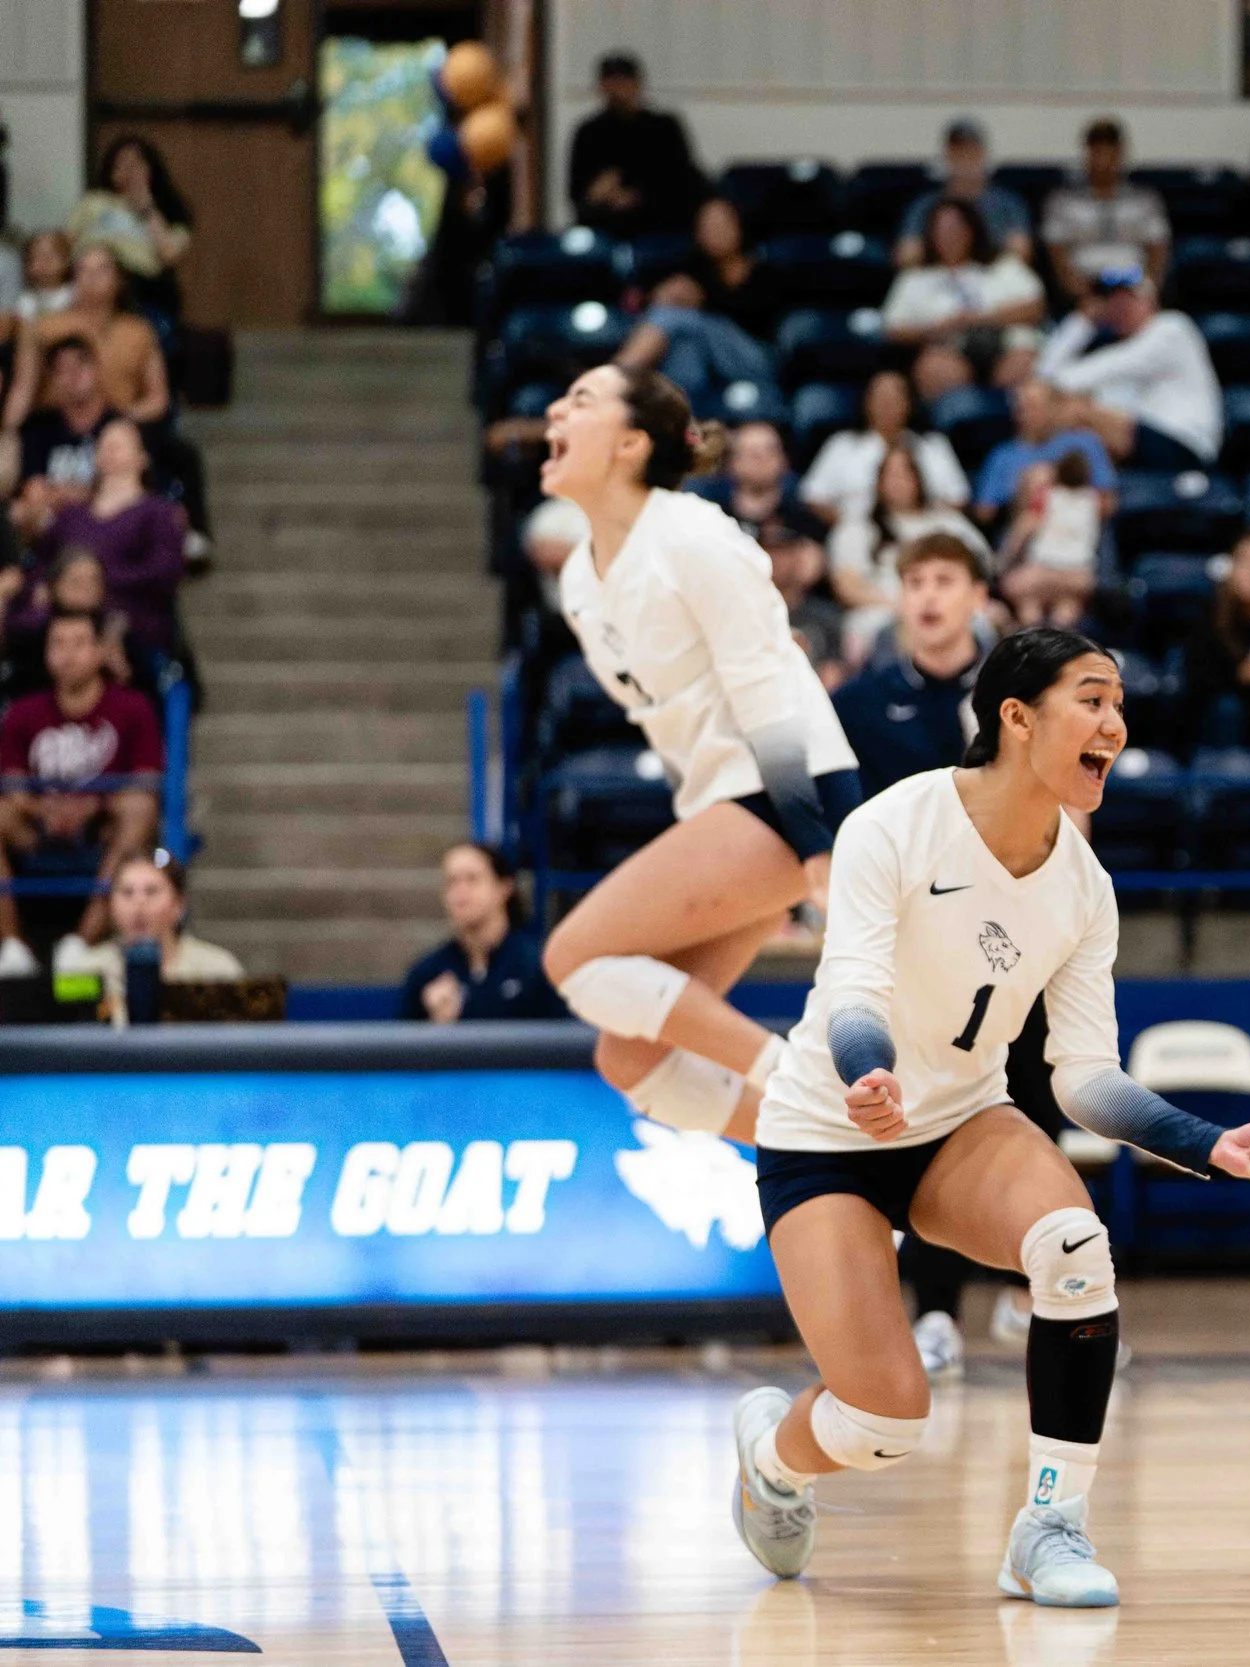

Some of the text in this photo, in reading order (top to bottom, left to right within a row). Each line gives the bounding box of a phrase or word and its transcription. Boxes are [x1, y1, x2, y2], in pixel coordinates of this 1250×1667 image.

[951, 983, 996, 1052] 1
[126, 1143, 317, 1239] THE
[330, 1139, 578, 1237] GOAT
